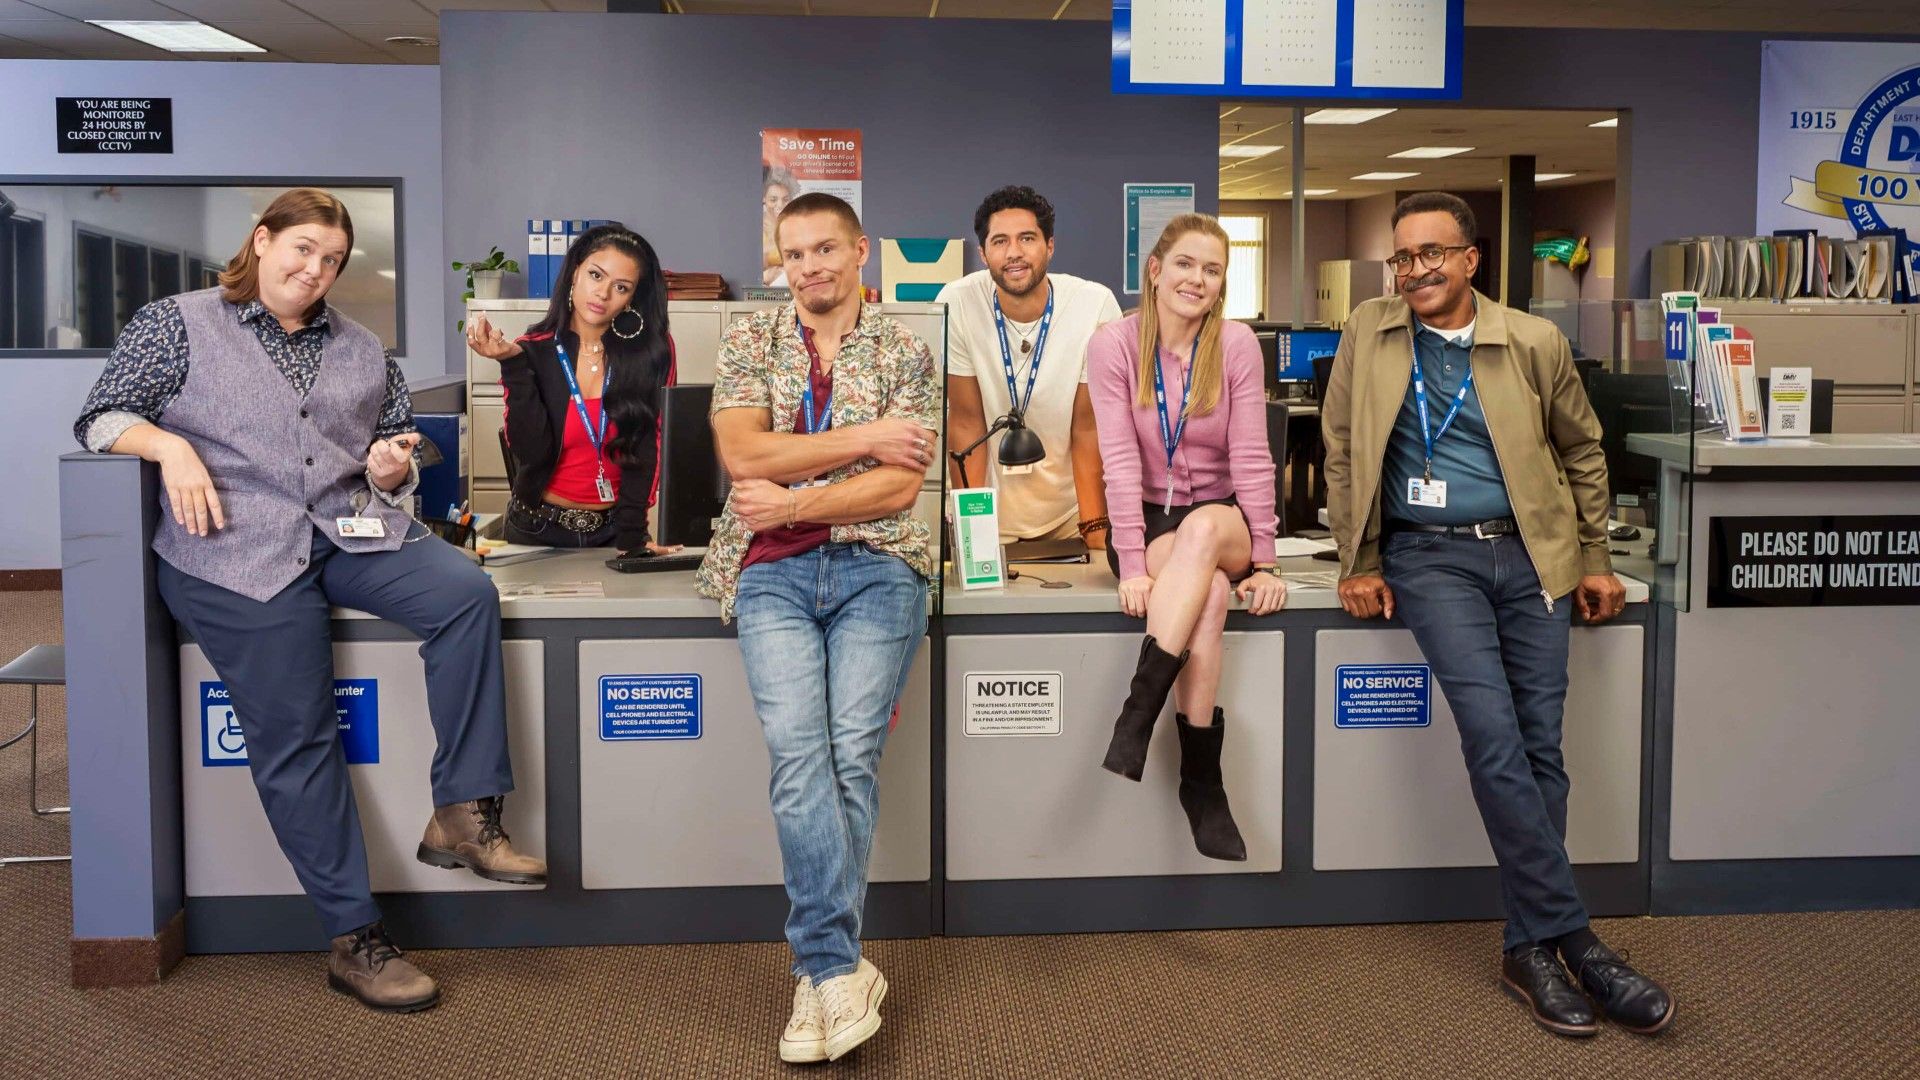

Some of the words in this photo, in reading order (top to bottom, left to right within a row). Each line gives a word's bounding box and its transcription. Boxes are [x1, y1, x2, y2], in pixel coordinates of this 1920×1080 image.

[76, 100, 98, 109] YOU
[100, 100, 118, 109] ARE
[121, 100, 151, 109] BEING
[83, 110, 144, 119] MONITORED
[1790, 111, 1836, 129] 1915
[1851, 80, 1910, 156] DEPARTMENT
[1894, 114, 1913, 122] EAST
[82, 121, 94, 129] 24
[96, 121, 132, 129] HOURS
[134, 121, 146, 129] BY
[68, 131, 106, 140] CLOSED
[108, 131, 146, 140] CIRCUIT
[148, 131, 162, 140] TV
[98, 142, 132, 150] (CCTV)
[780, 138, 814, 150] Save
[819, 138, 854, 150] Time
[1858, 174, 1908, 200] 100
[1853, 203, 1878, 231] STA
[1670, 321, 1683, 350] 11
[1741, 532, 1808, 556] PLEASE
[1814, 531, 1839, 556] DO
[1845, 531, 1882, 555] NOT
[1887, 531, 1920, 555] LEA
[1732, 564, 1822, 589] CHILDREN
[1829, 563, 1920, 587] UNATTEND
[977, 681, 1049, 696] NOTICE
[1343, 678, 1363, 689] NO
[1366, 677, 1424, 689] SERVICE
[207, 688, 229, 698] Acc
[334, 686, 364, 696] unter
[607, 688, 629, 700] NO
[631, 687, 693, 700] SERVICE
